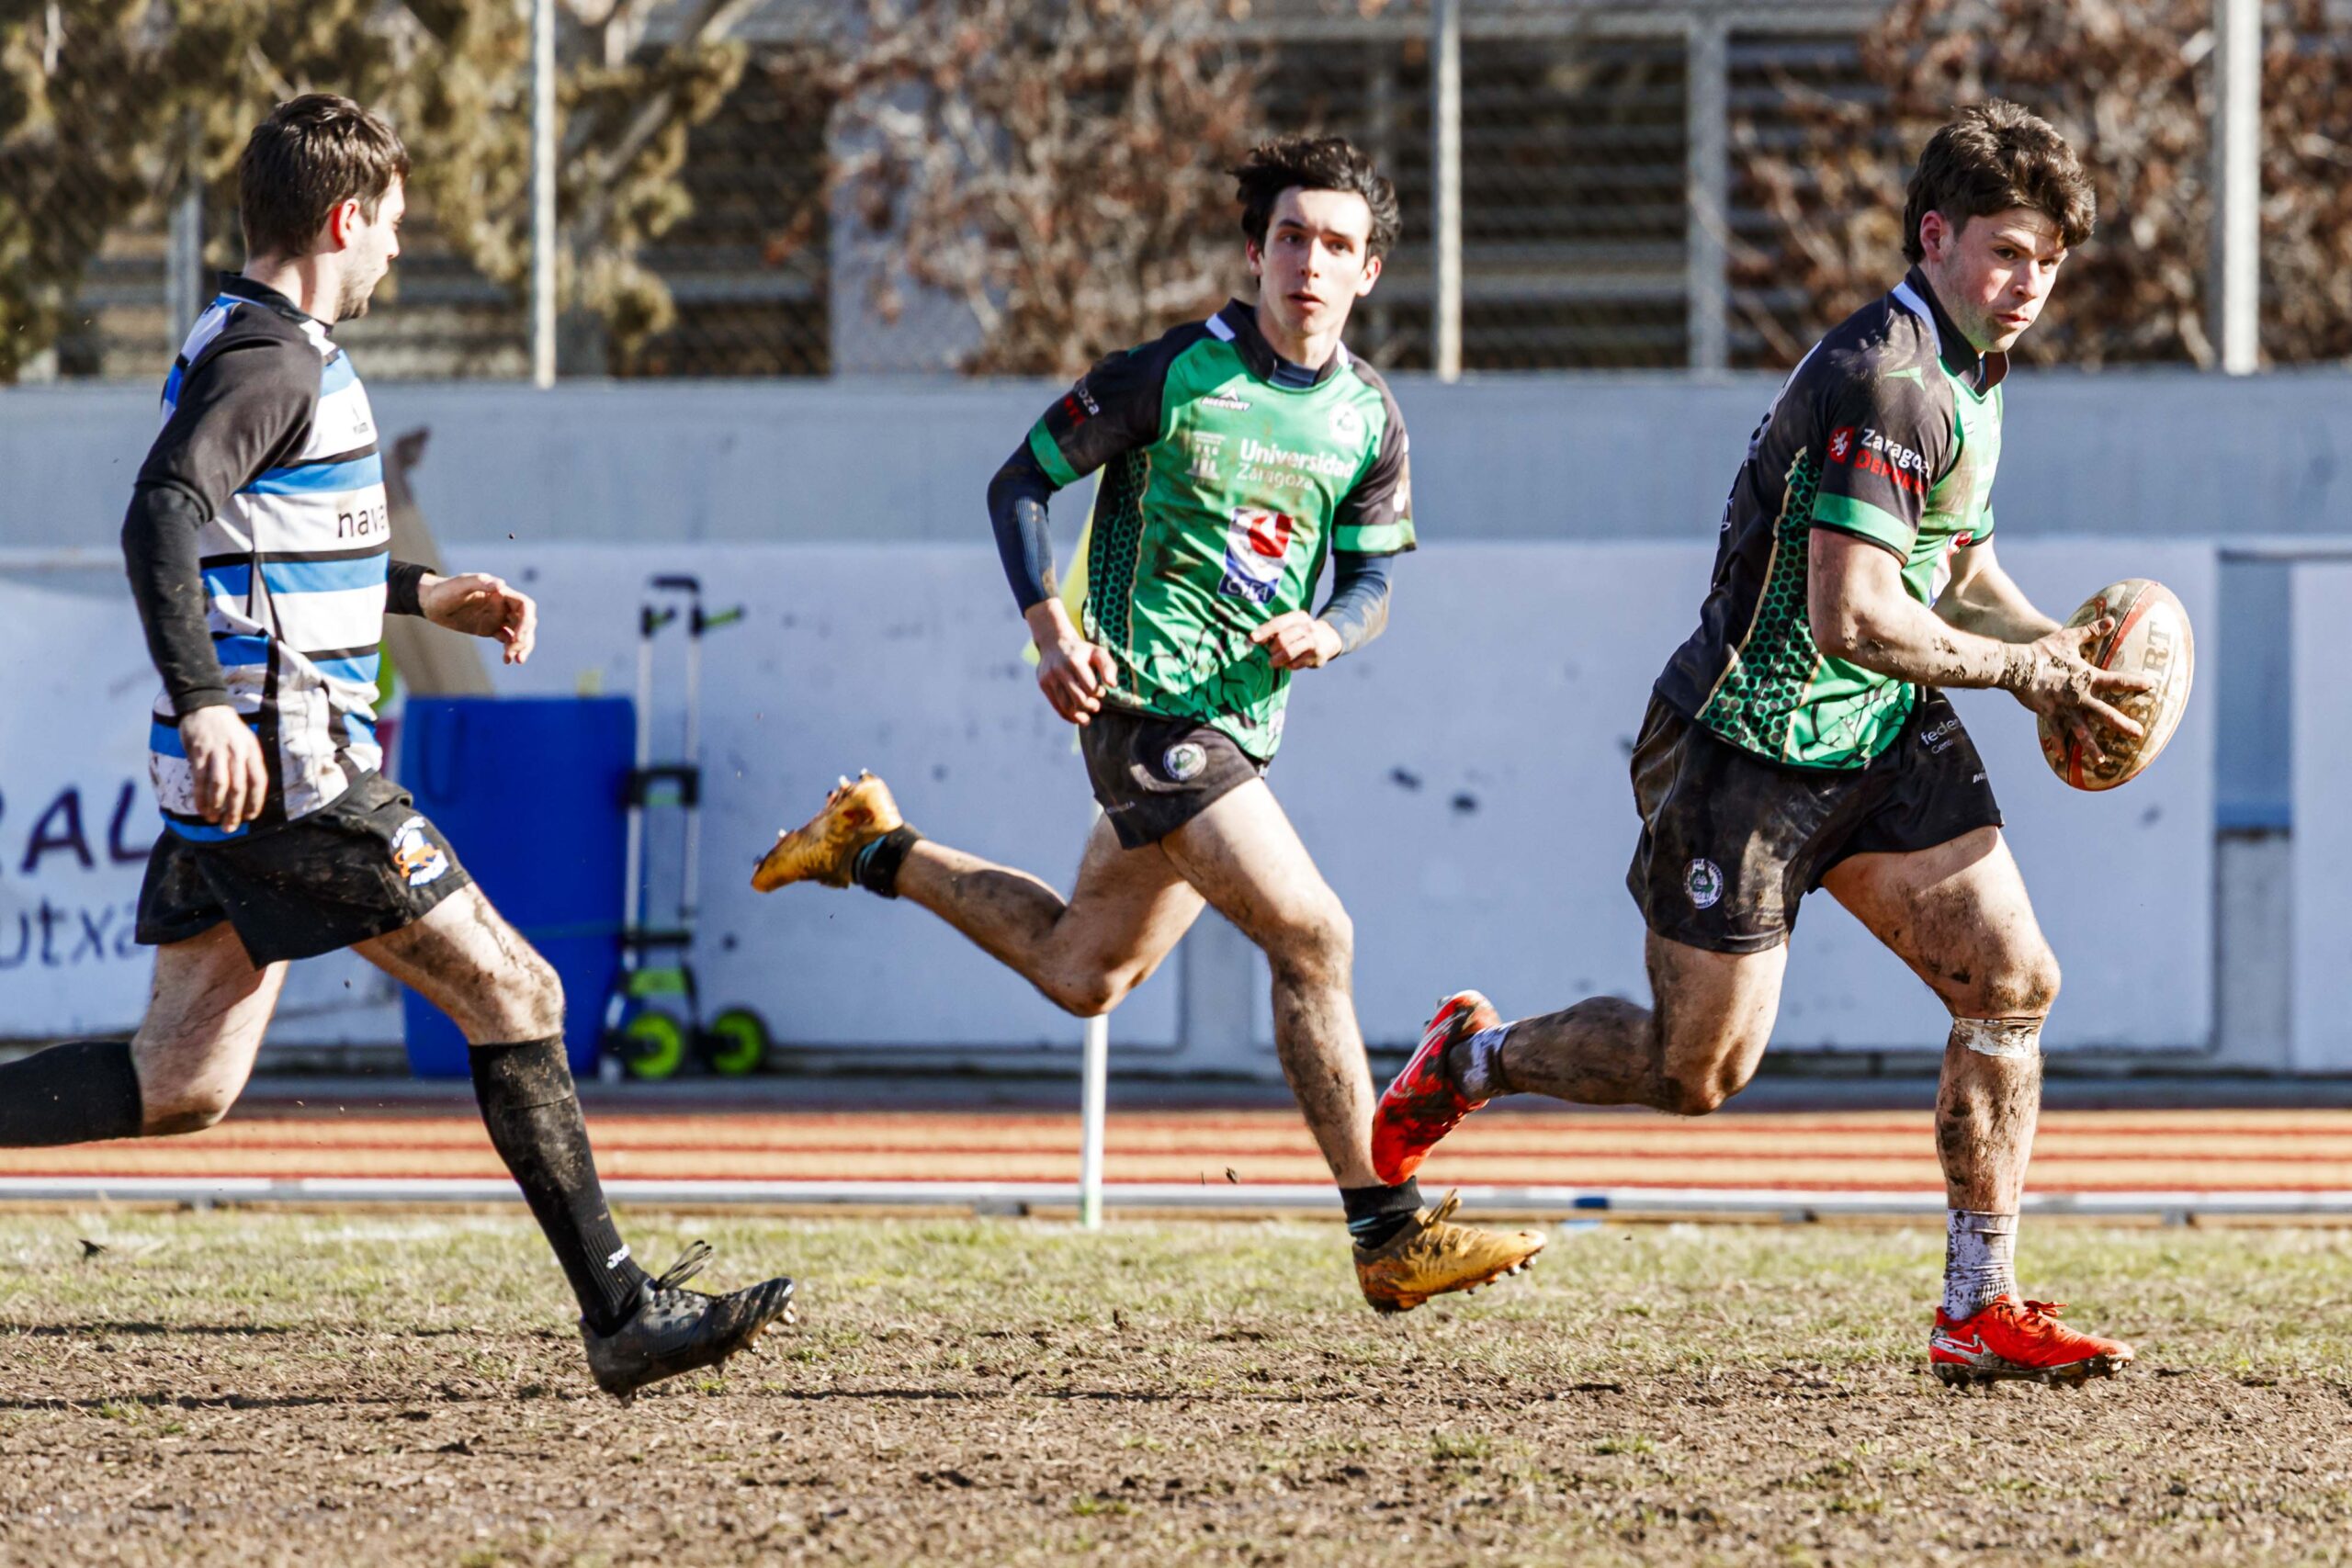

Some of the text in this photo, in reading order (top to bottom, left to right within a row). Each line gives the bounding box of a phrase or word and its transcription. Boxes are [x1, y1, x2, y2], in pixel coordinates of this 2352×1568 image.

[1236, 461, 1316, 491] Zaragoza
[1239, 438, 1359, 479] Universidad
[0, 777, 152, 874] AL
